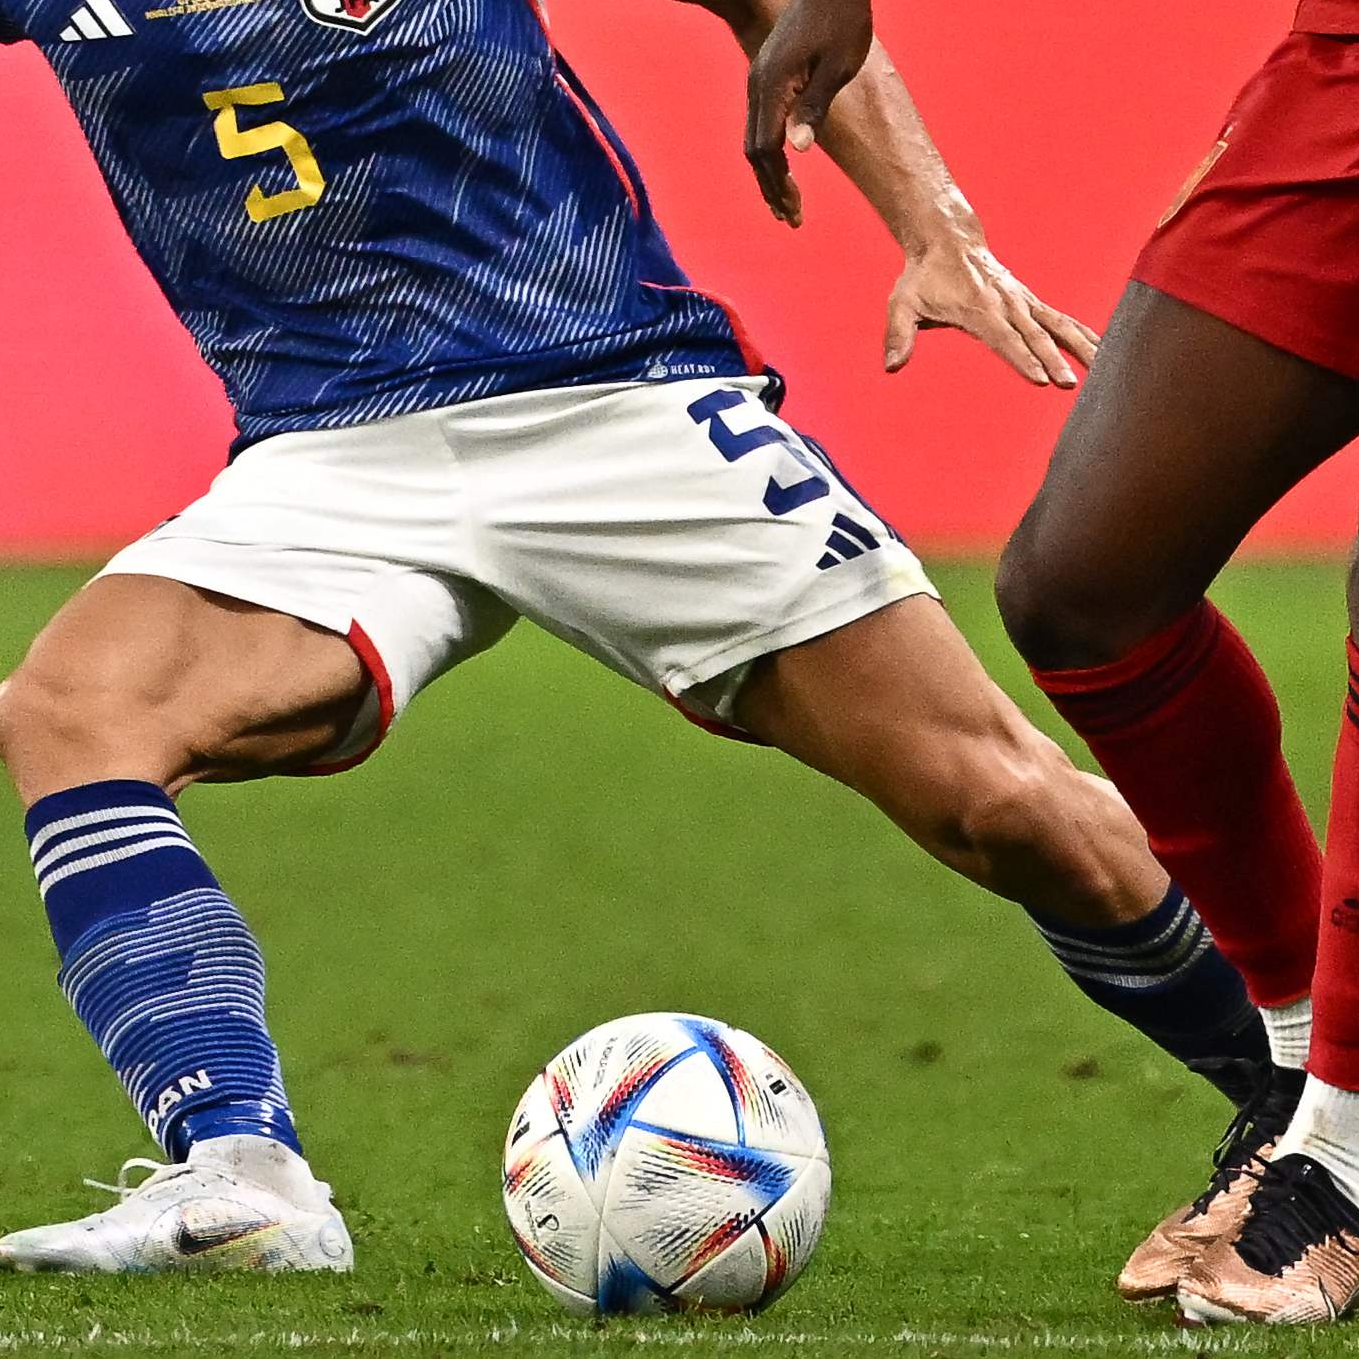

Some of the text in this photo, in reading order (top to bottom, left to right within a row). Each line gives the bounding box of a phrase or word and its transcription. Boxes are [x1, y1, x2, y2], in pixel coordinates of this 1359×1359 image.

[202, 81, 328, 224] 5
[687, 389, 830, 516] 5
[148, 1069, 213, 1140] PAN
